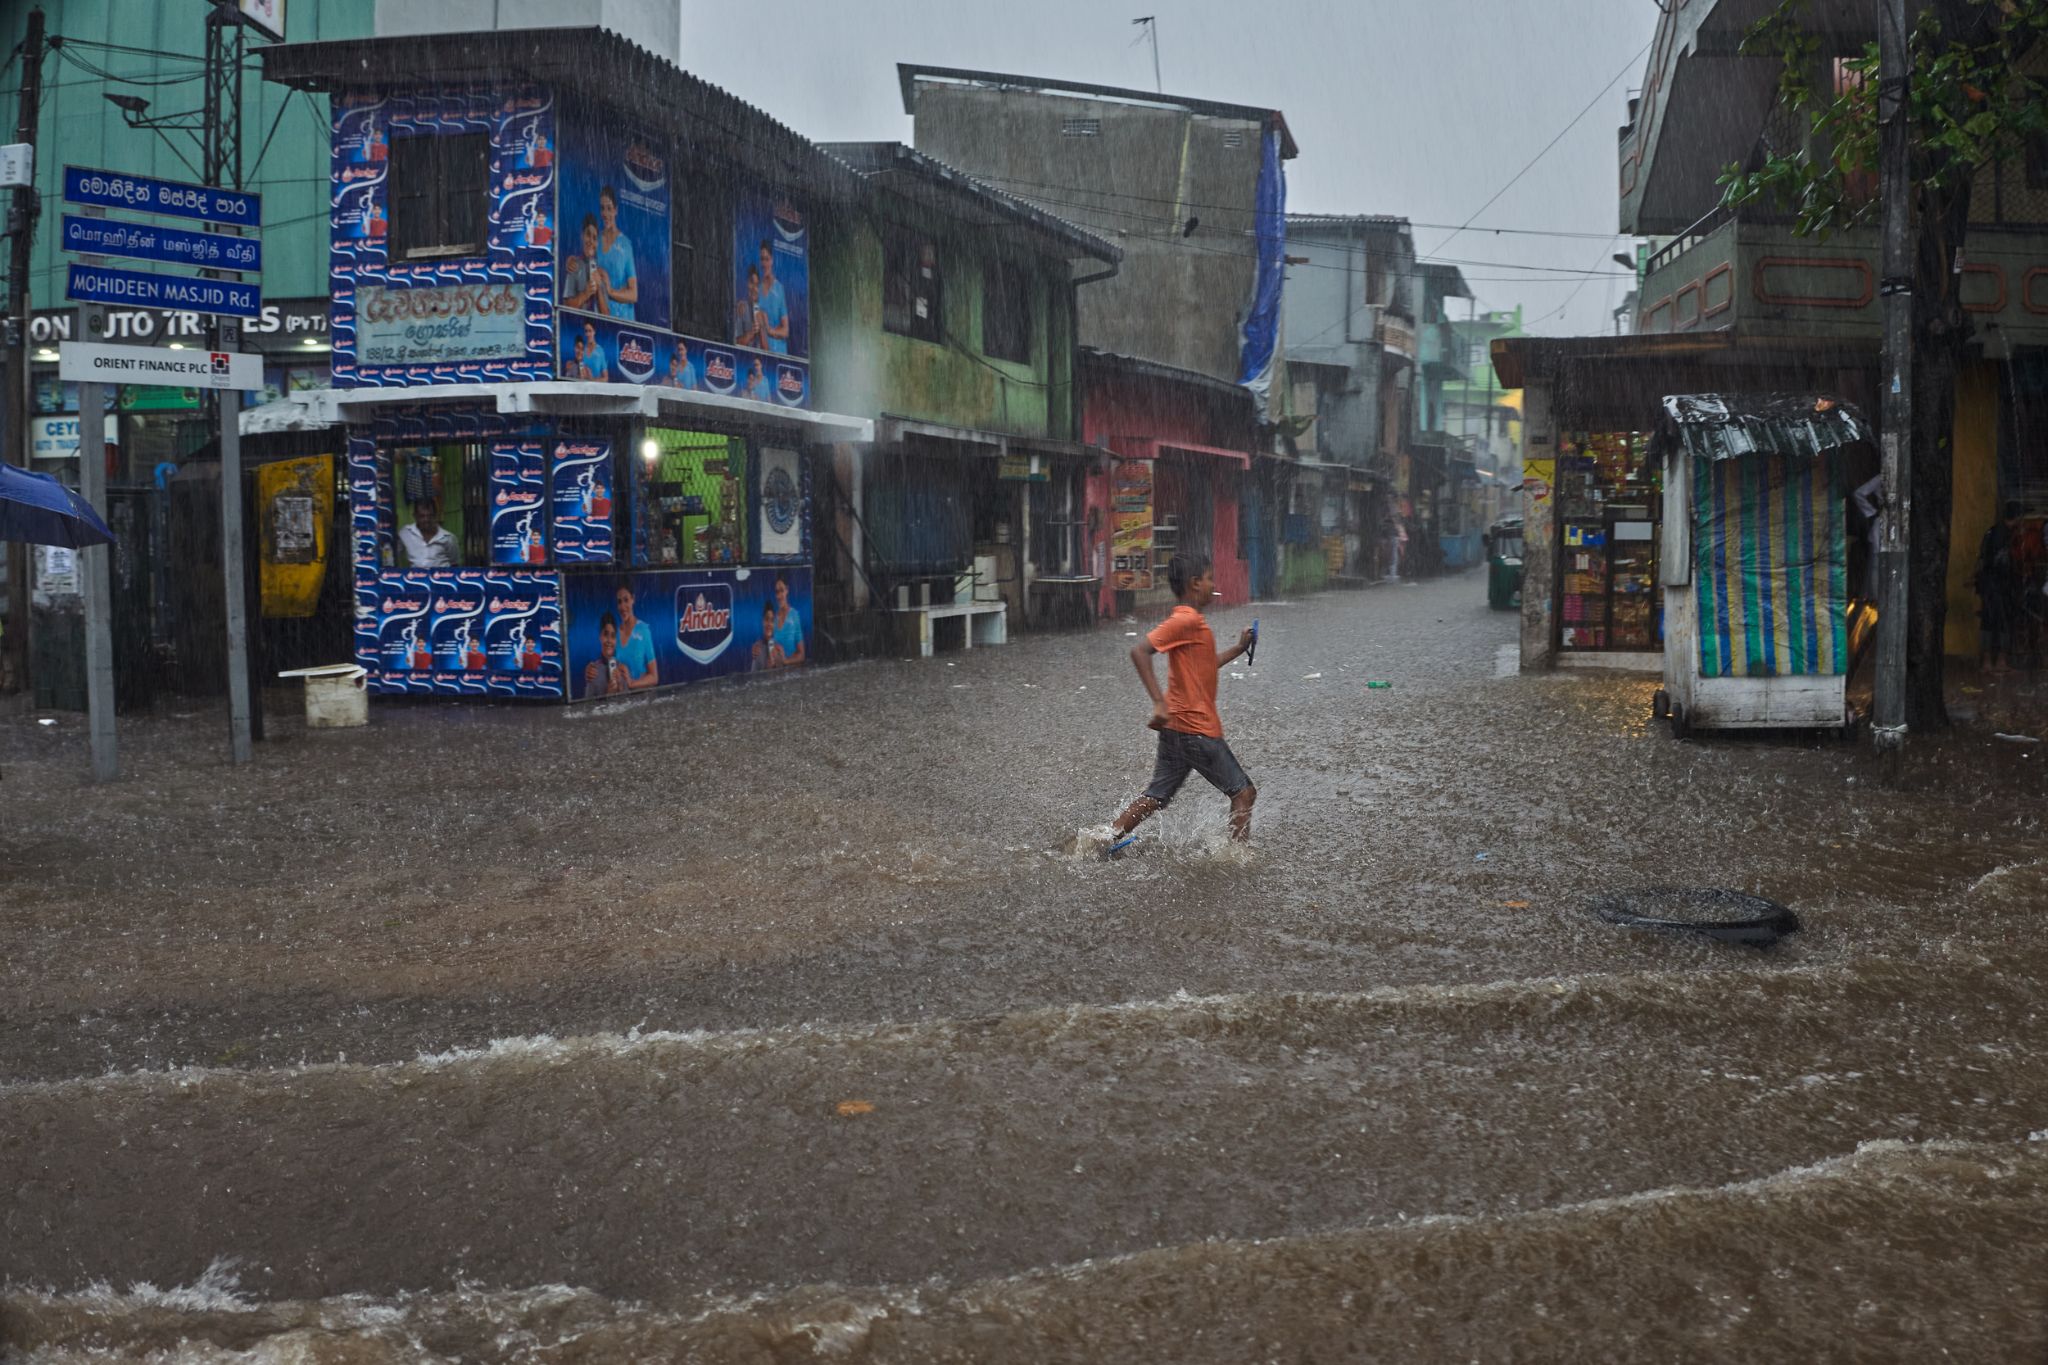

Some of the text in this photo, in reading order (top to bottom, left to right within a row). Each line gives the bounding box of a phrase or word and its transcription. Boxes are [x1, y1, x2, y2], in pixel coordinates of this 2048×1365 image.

[215, 198, 247, 215] පාර
[226, 243, 256, 263] வீதி
[73, 275, 255, 309] MOHIDEEN MASJID Rd.
[30, 314, 71, 342] ON
[94, 357, 208, 374] ORIENT FINANCE PLC
[679, 601, 730, 633] Anchor
